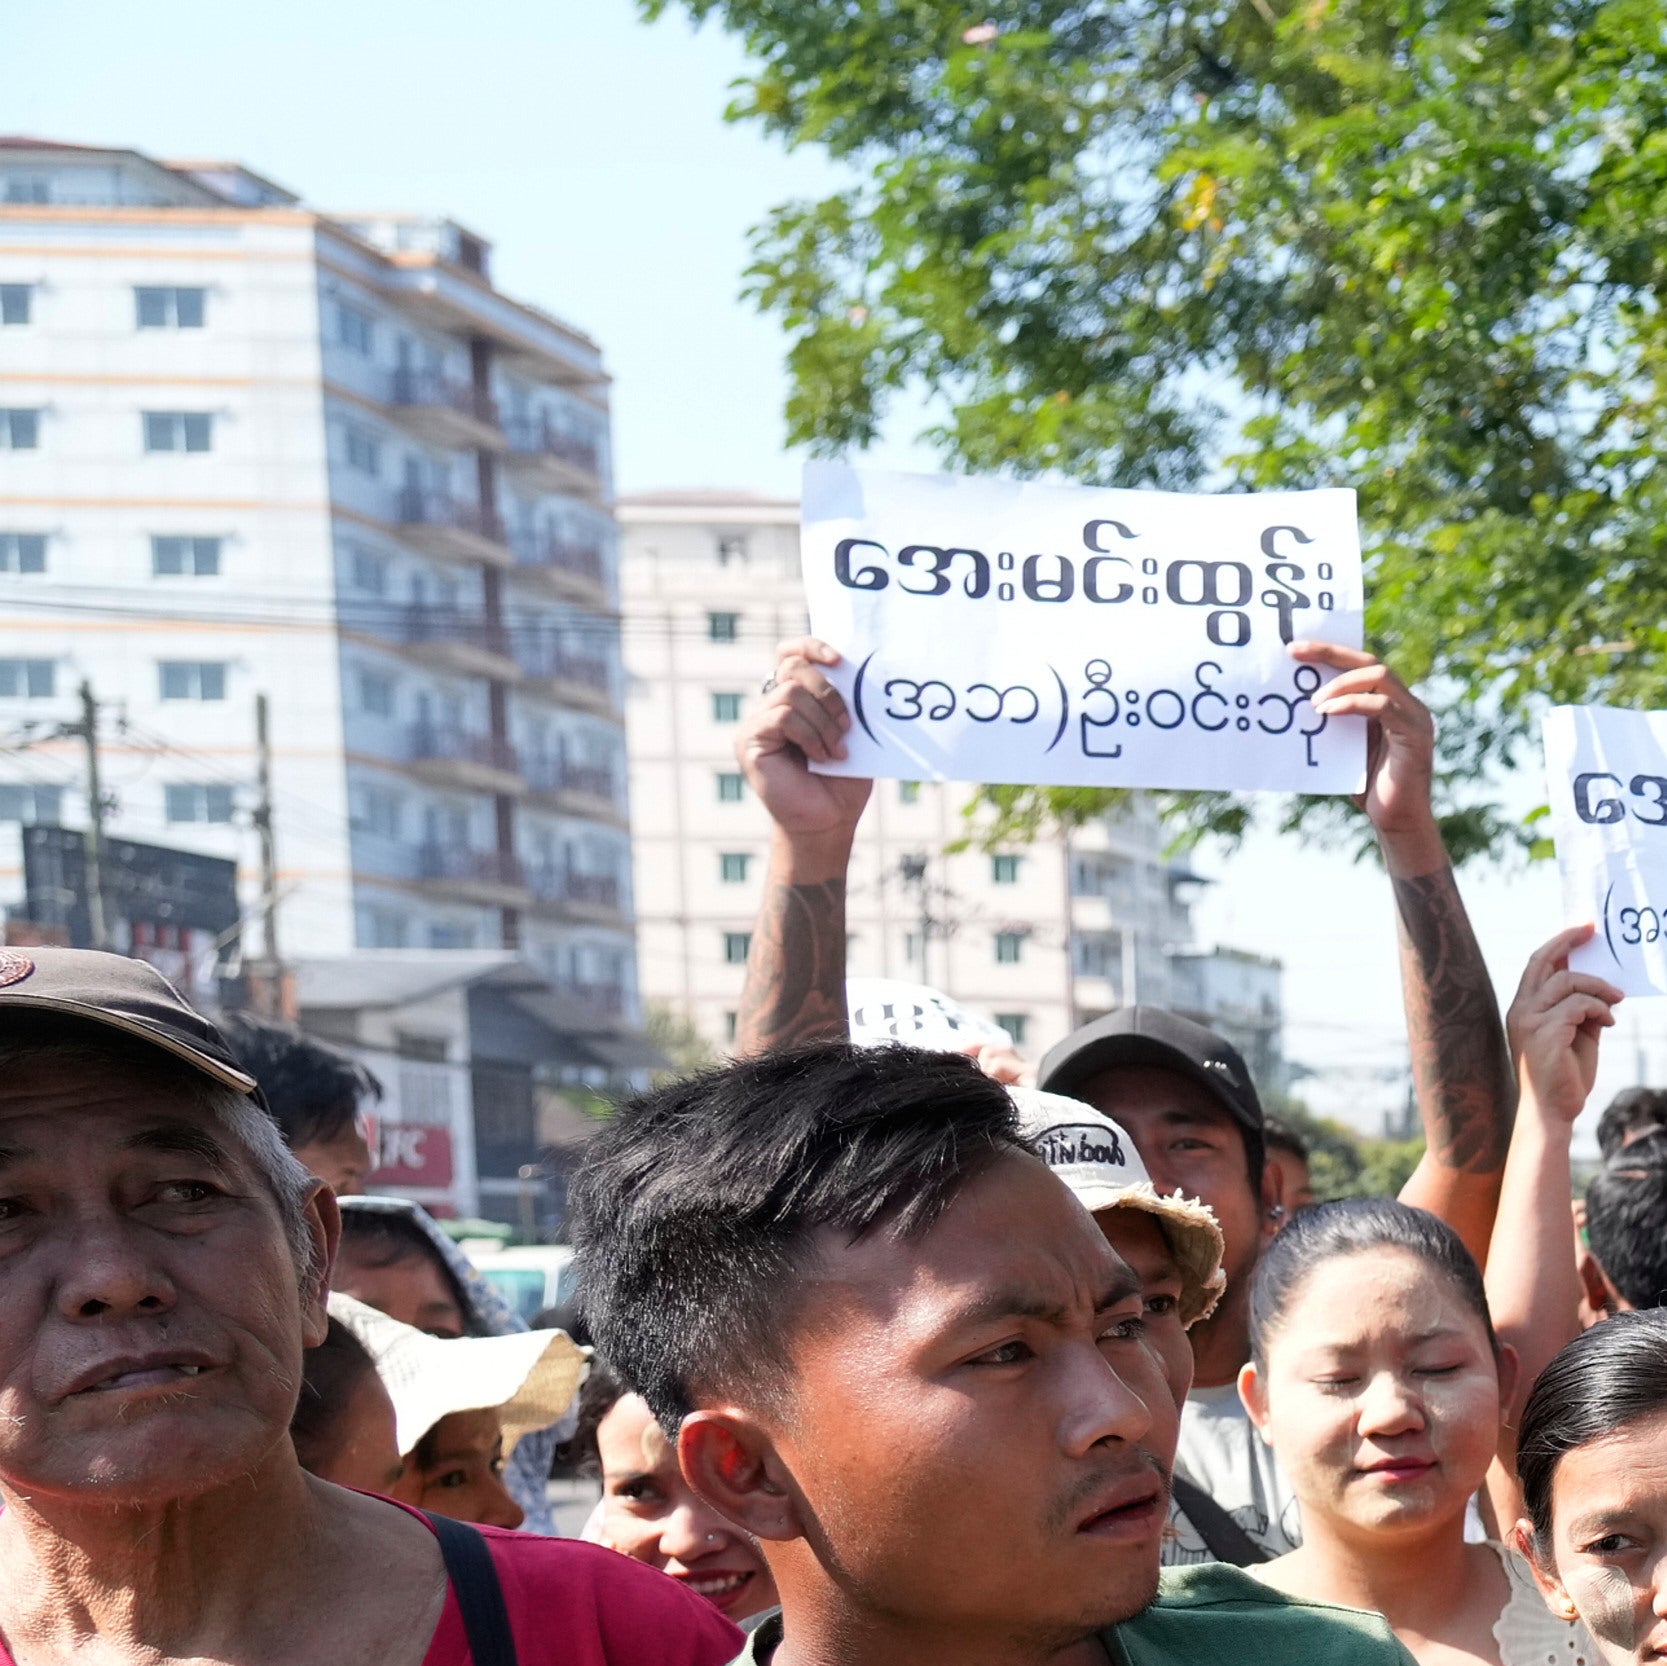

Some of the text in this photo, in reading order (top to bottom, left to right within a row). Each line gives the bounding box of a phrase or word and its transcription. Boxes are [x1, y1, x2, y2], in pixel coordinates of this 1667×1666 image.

[833, 518, 1335, 648] အေးမင်းထွန်း
